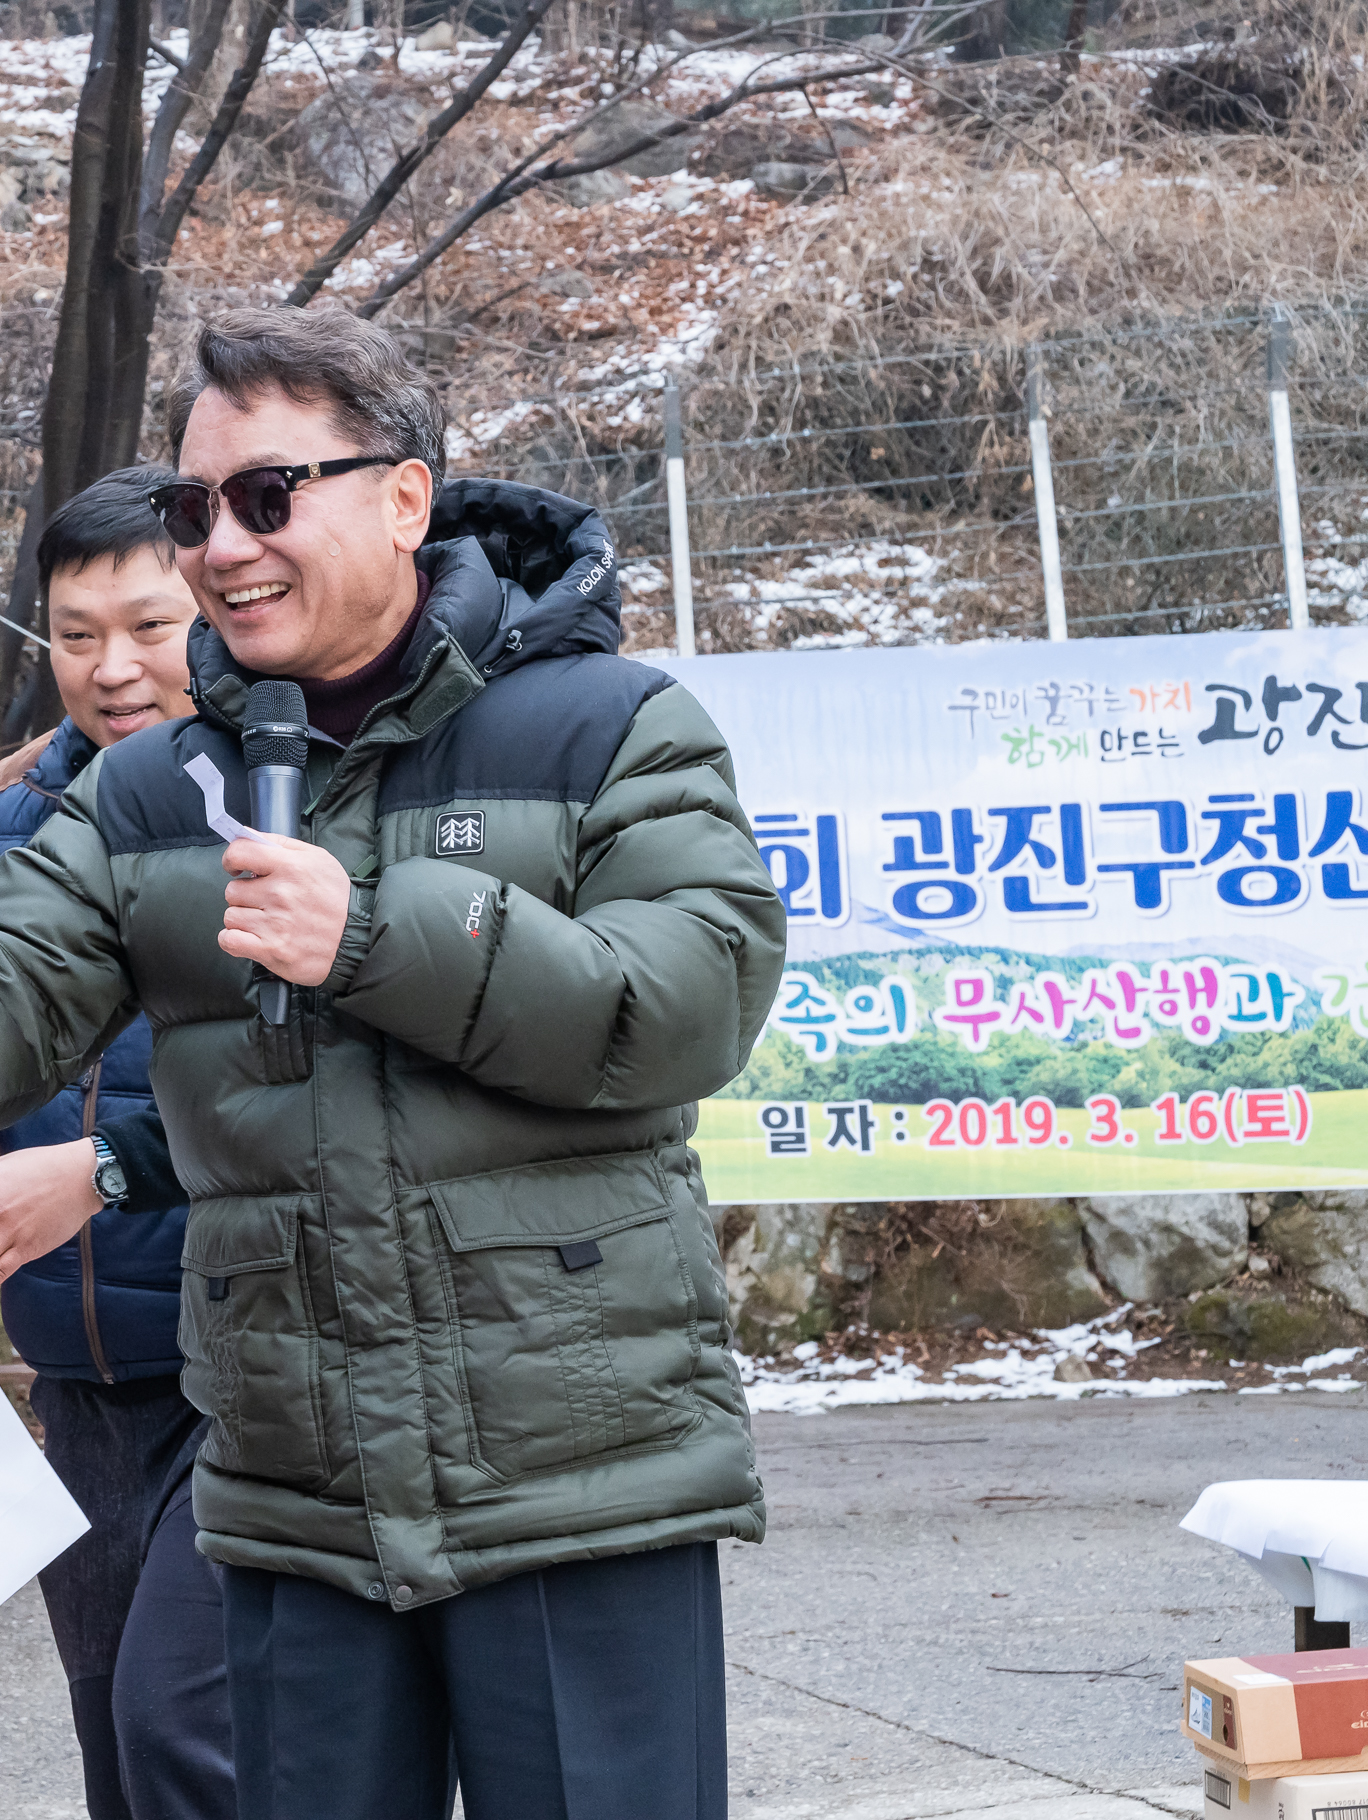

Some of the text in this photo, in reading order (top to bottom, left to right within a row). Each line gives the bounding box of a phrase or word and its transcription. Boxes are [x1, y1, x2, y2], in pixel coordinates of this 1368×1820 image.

[577, 564, 606, 596] KOLON
[948, 681, 1192, 739] 구민이 꿈꾸는 가치
[1001, 725, 1184, 769] 함께 만드는
[942, 966, 1296, 1043] 무사산행과
[761, 1106, 807, 1153] 일
[827, 1104, 875, 1152] 자
[925, 1101, 1069, 1146] 2019.
[1090, 1098, 1135, 1143] 3.
[1155, 1090, 1310, 1143] 16(토)
